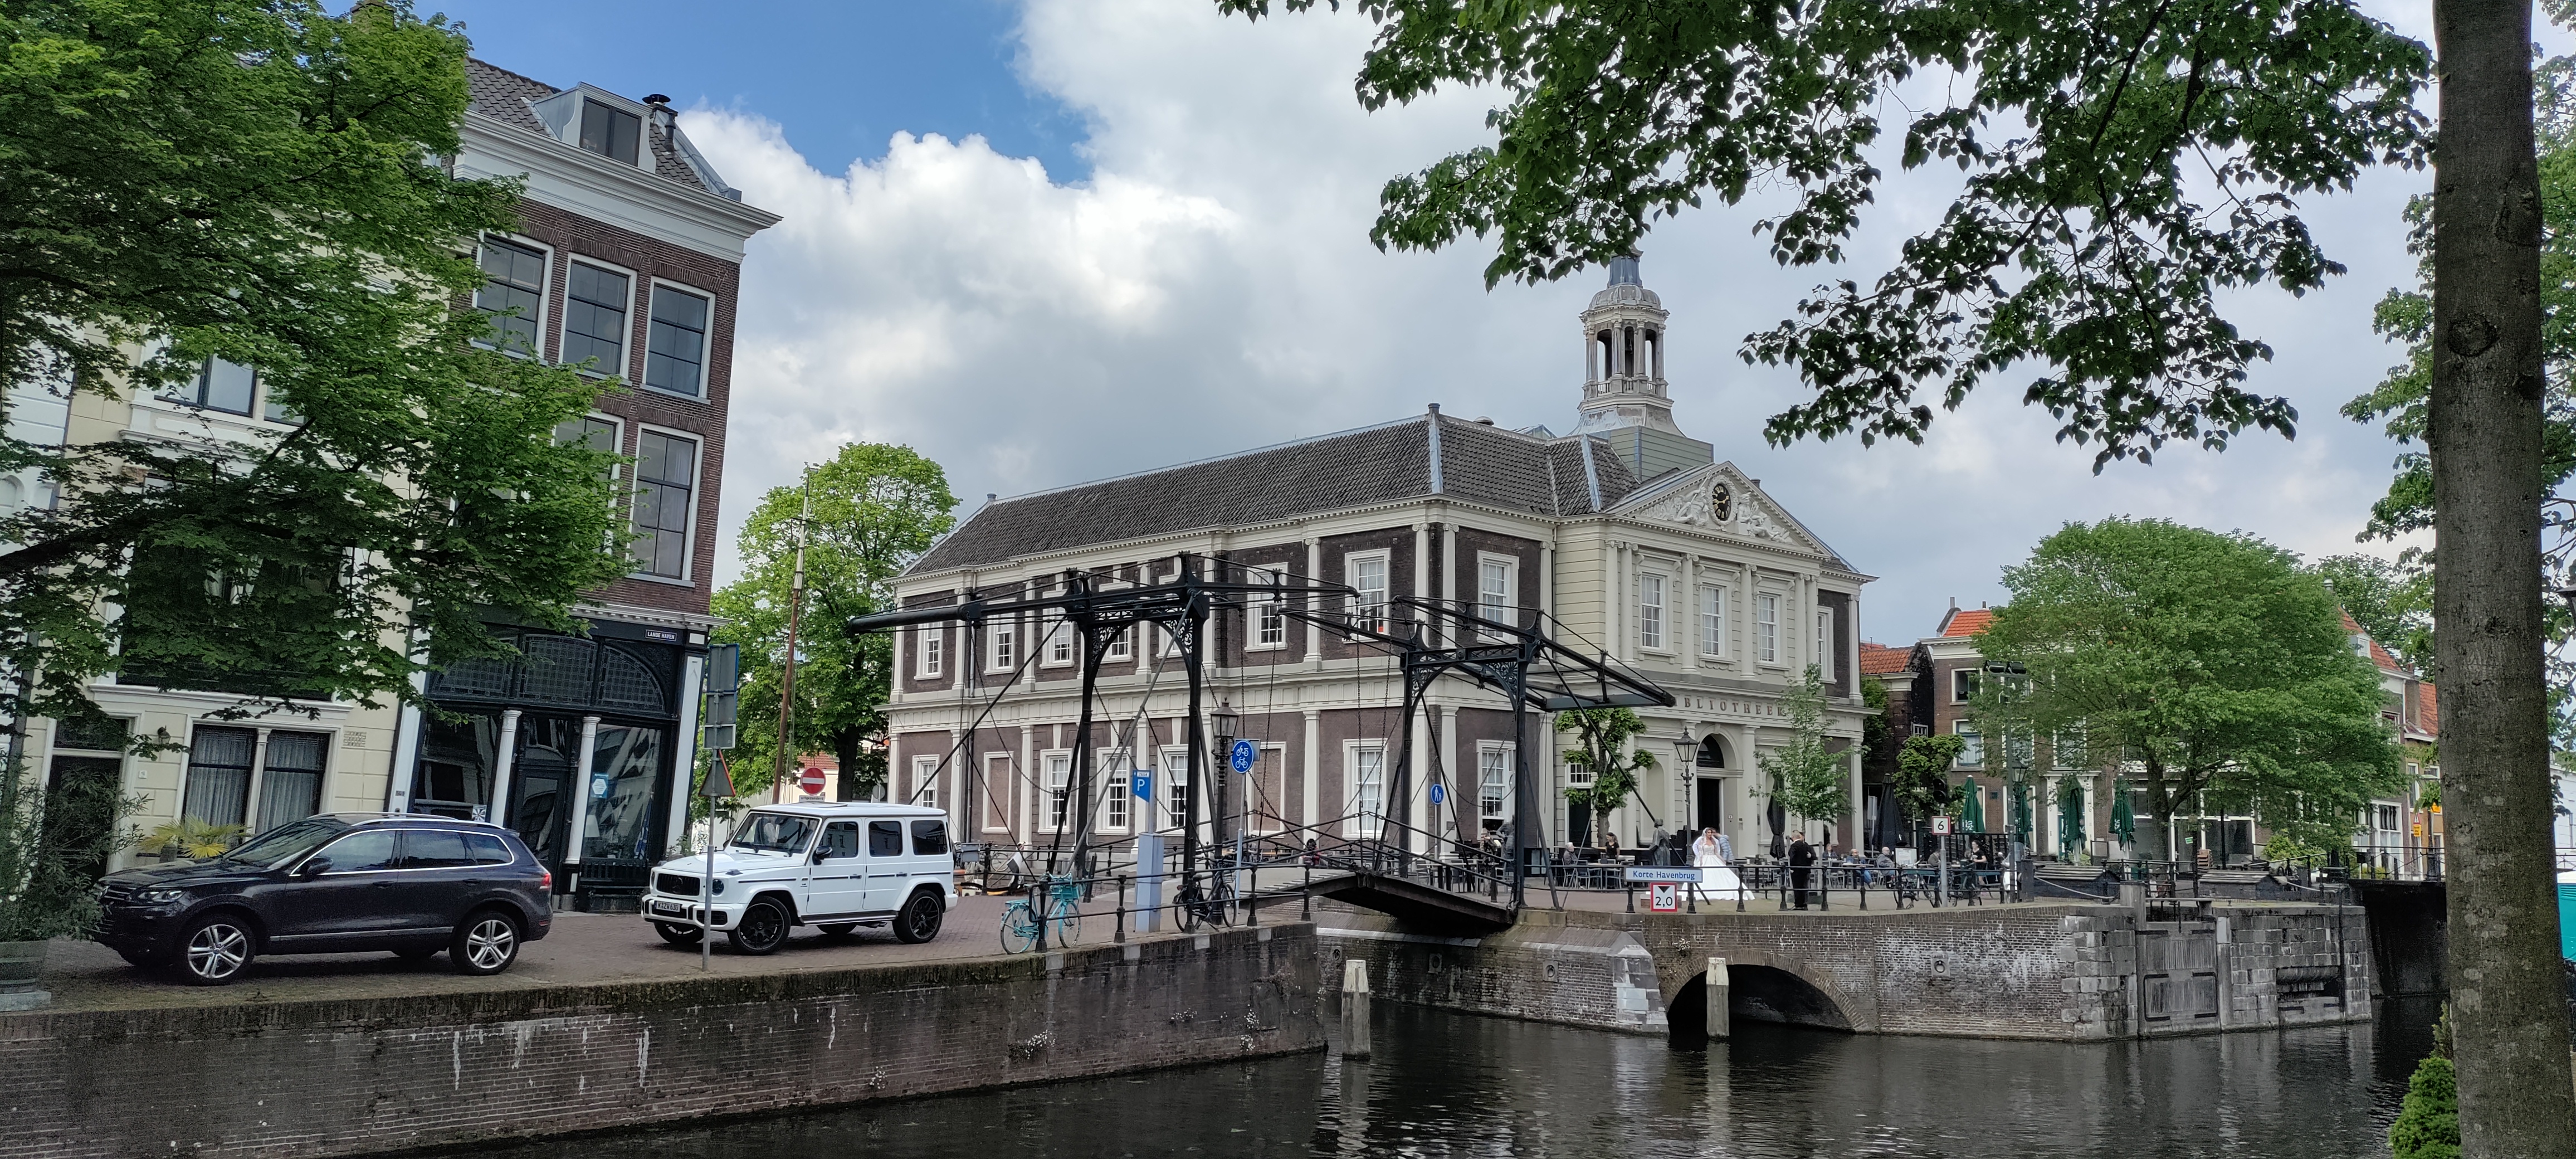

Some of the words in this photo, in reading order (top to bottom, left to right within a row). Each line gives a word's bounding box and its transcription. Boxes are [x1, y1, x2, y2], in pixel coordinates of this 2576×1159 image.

[1137, 779, 1145, 791] P
[1938, 821, 1944, 830] 6
[1656, 871, 1695, 880] Havenbrug
[1655, 897, 1673, 908] 2,0
